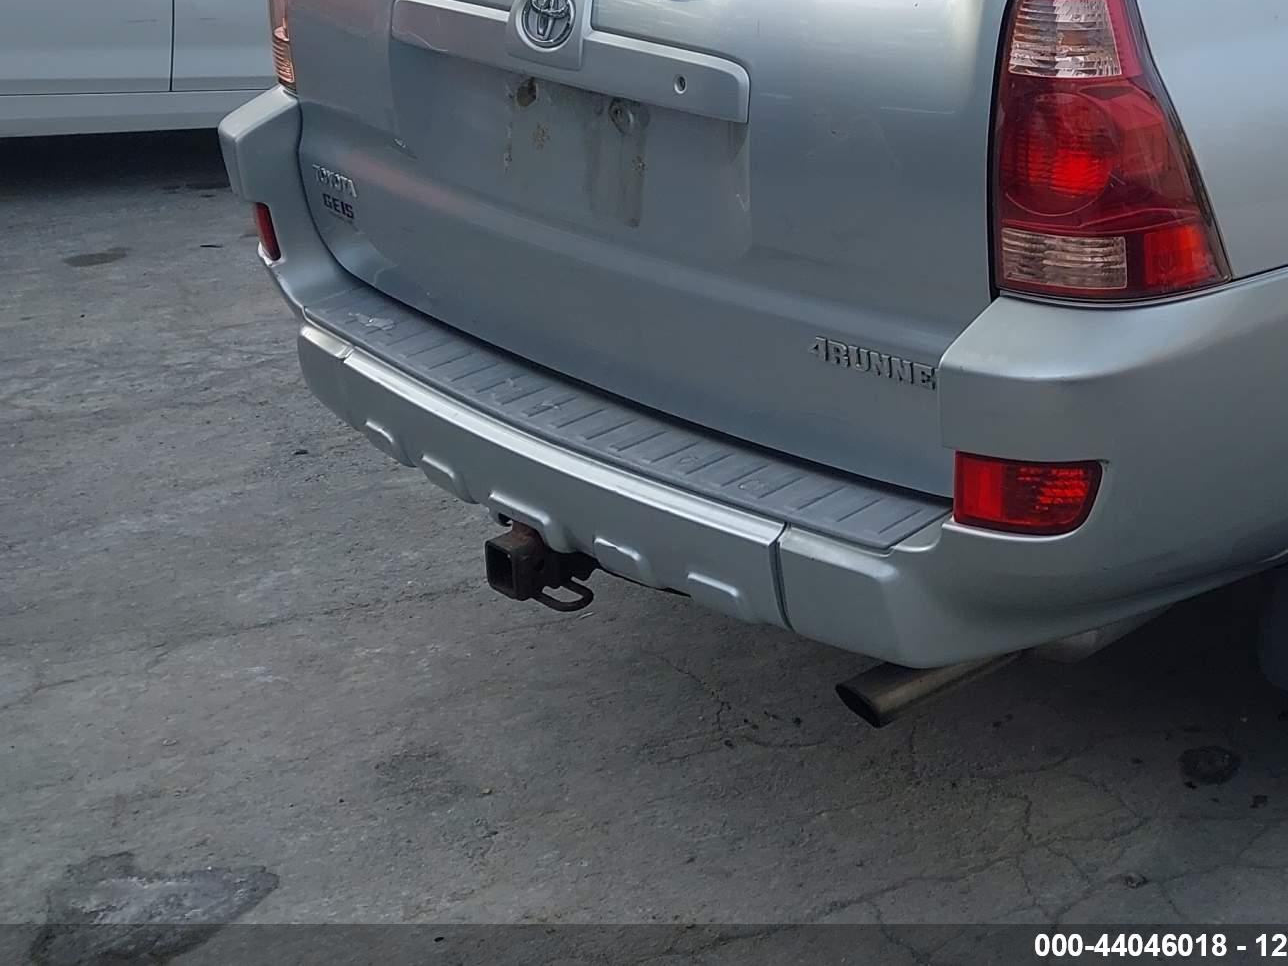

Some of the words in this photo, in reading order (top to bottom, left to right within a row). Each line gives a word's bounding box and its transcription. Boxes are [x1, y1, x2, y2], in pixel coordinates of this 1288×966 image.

[312, 163, 357, 198] TOYOTA
[322, 193, 355, 219] GEIS
[809, 335, 939, 390] 4RUNNE
